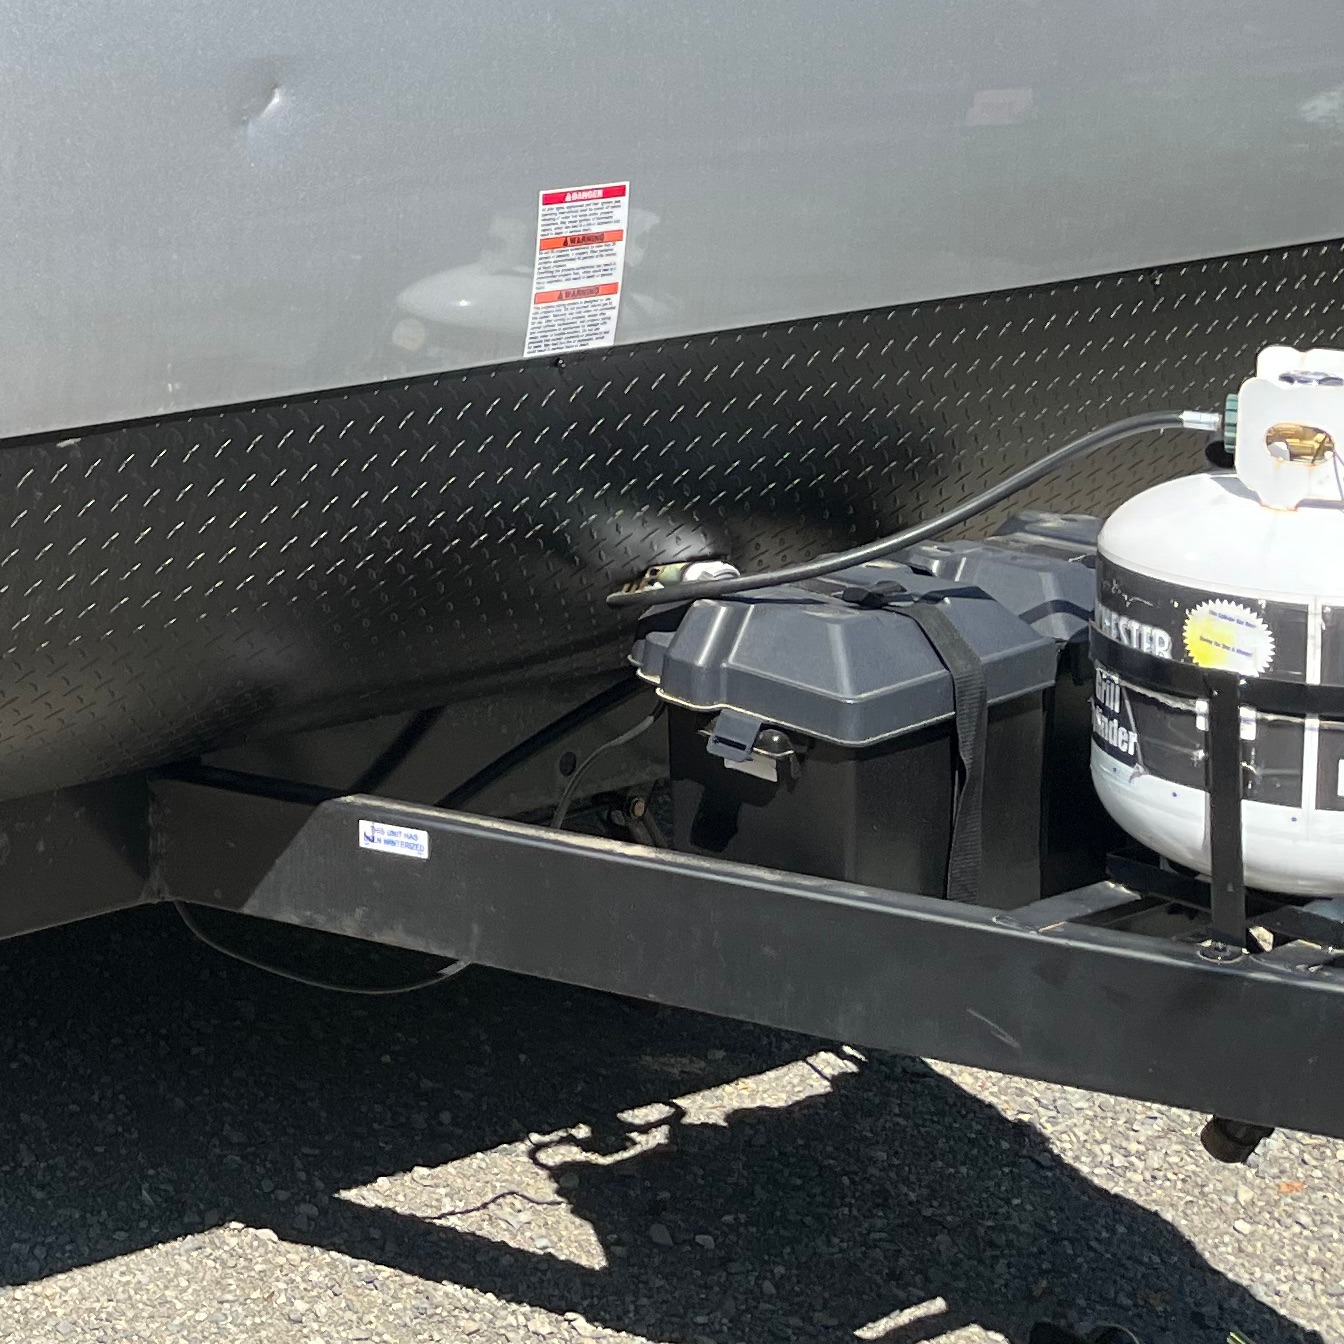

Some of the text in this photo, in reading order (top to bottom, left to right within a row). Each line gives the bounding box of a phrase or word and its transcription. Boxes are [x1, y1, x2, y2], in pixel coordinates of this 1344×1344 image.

[571, 189, 604, 202] DANGER
[569, 233, 605, 245] WARNING
[565, 287, 600, 299] WARNING
